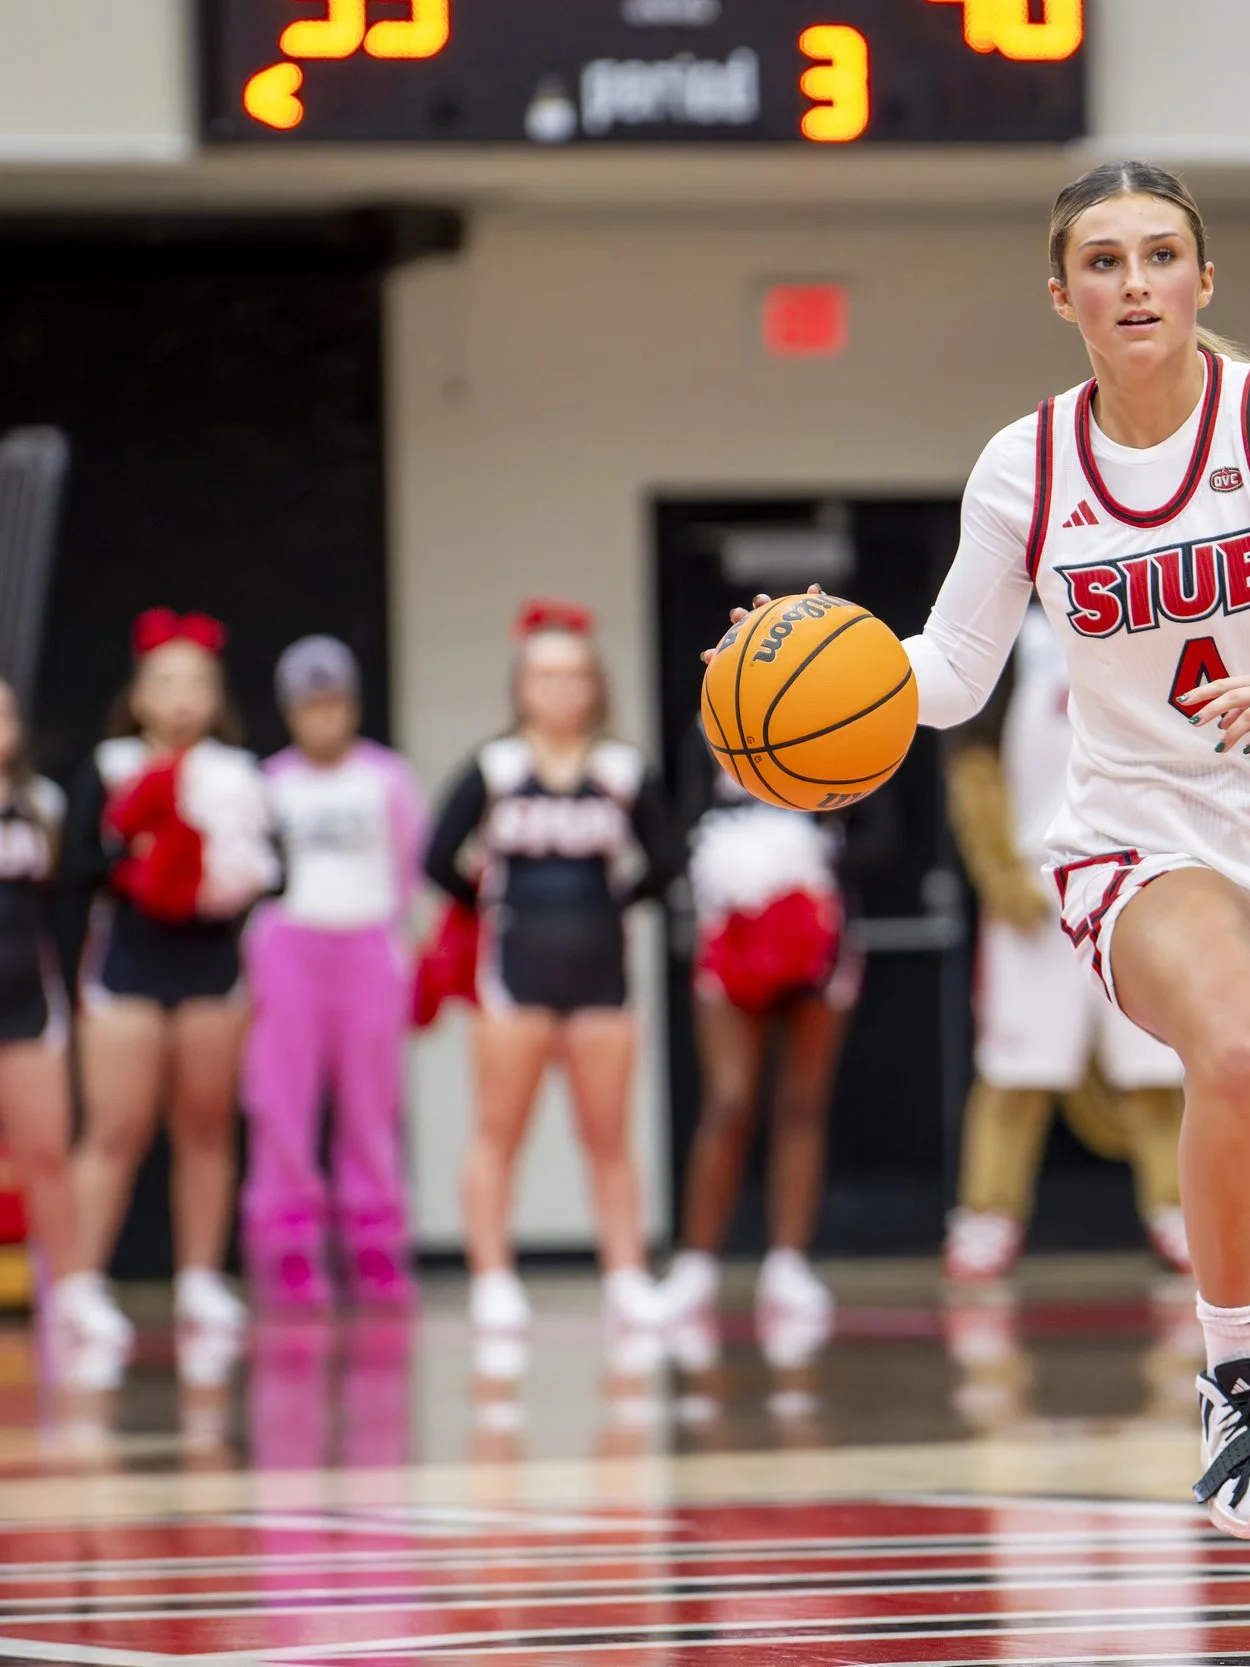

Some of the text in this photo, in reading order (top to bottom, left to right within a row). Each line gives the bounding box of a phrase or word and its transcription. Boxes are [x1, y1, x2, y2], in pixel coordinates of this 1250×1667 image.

[581, 46, 758, 136] period
[799, 23, 869, 142] 3
[1213, 472, 1239, 488] OVC
[1168, 636, 1240, 724] 4
